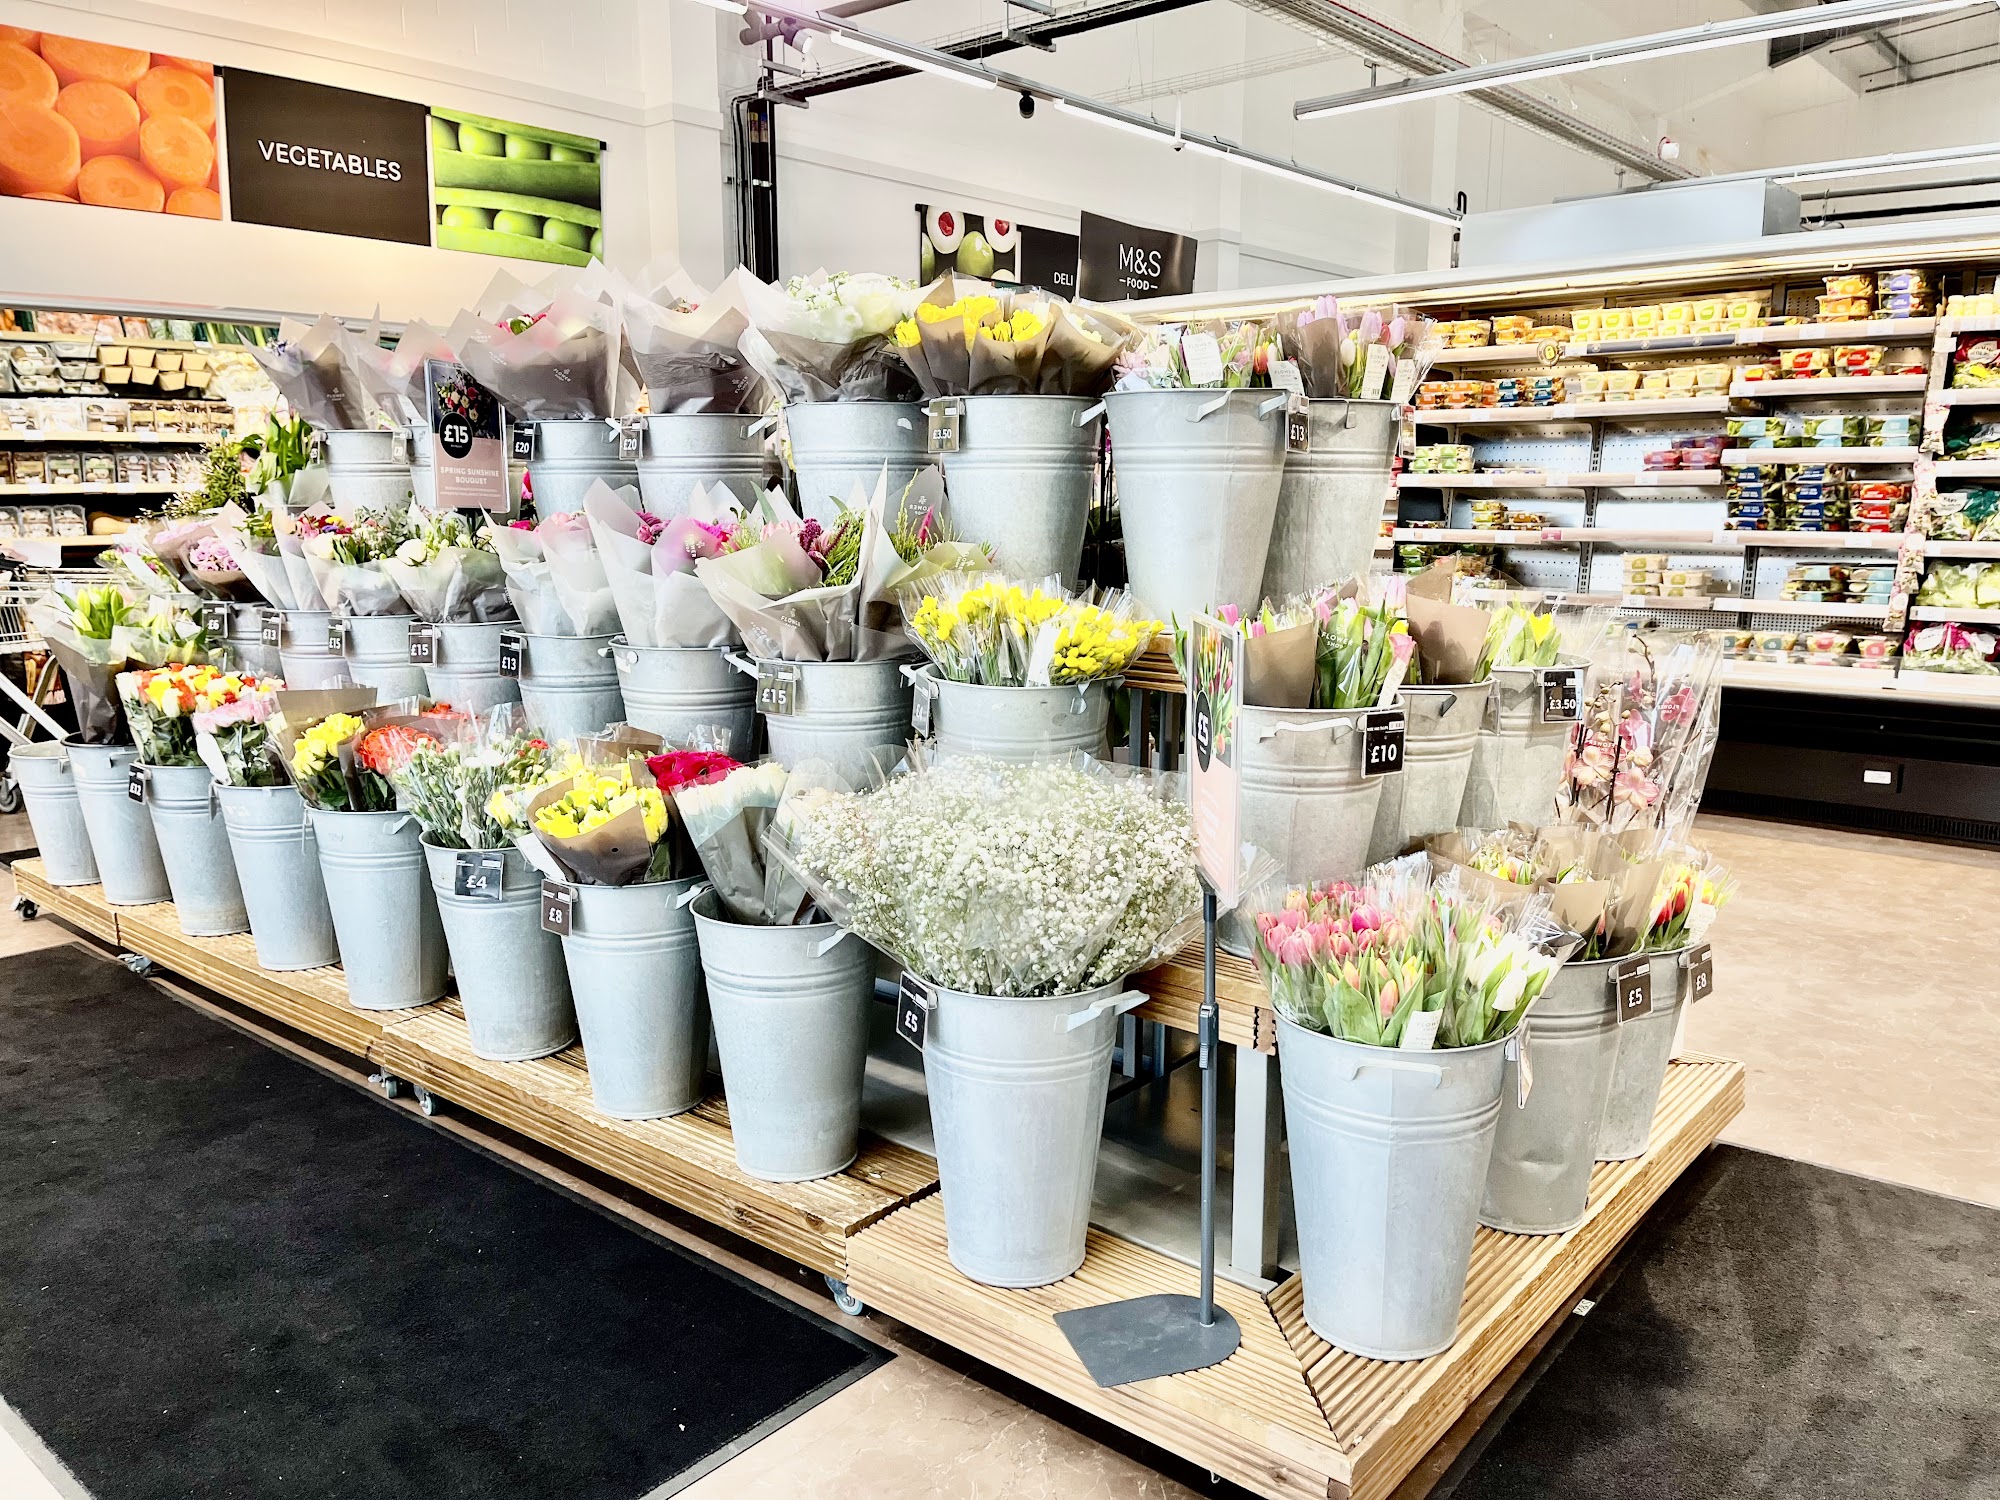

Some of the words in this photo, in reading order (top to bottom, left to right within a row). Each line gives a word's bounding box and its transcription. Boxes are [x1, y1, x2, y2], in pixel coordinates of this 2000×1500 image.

[257, 139, 403, 182] VEGETABLES
[1119, 243, 1162, 277] M&S
[1053, 271, 1075, 286] DELI
[1126, 276, 1150, 291] FOOD
[553, 368, 571, 382] FLOWER
[734, 376, 749, 394] FLOWER
[444, 424, 469, 444] £15
[933, 428, 952, 440] £3.50
[1291, 423, 1304, 442] £13
[514, 441, 530, 454] £20
[623, 438, 637, 451] £20
[440, 466, 466, 475] SPRING
[467, 468, 500, 477] SUNSHINE
[455, 476, 487, 485] BOUQUET
[208, 619, 220, 630] £6
[262, 628, 277, 641] £13
[1321, 631, 1354, 646] FLOWER
[328, 637, 341, 650] £15
[410, 643, 429, 656] £15
[1327, 641, 1343, 649] SHOP
[501, 656, 517, 671] £13
[761, 687, 787, 705] £15
[1549, 699, 1576, 710] £3.50
[1198, 711, 1209, 747] £5
[1370, 743, 1398, 763] £10
[129, 782, 142, 796] £12
[466, 874, 488, 890] £4
[548, 907, 563, 924] £8
[1696, 972, 1708, 991] £8
[1628, 987, 1643, 1008] £5
[904, 1010, 918, 1033] £5
